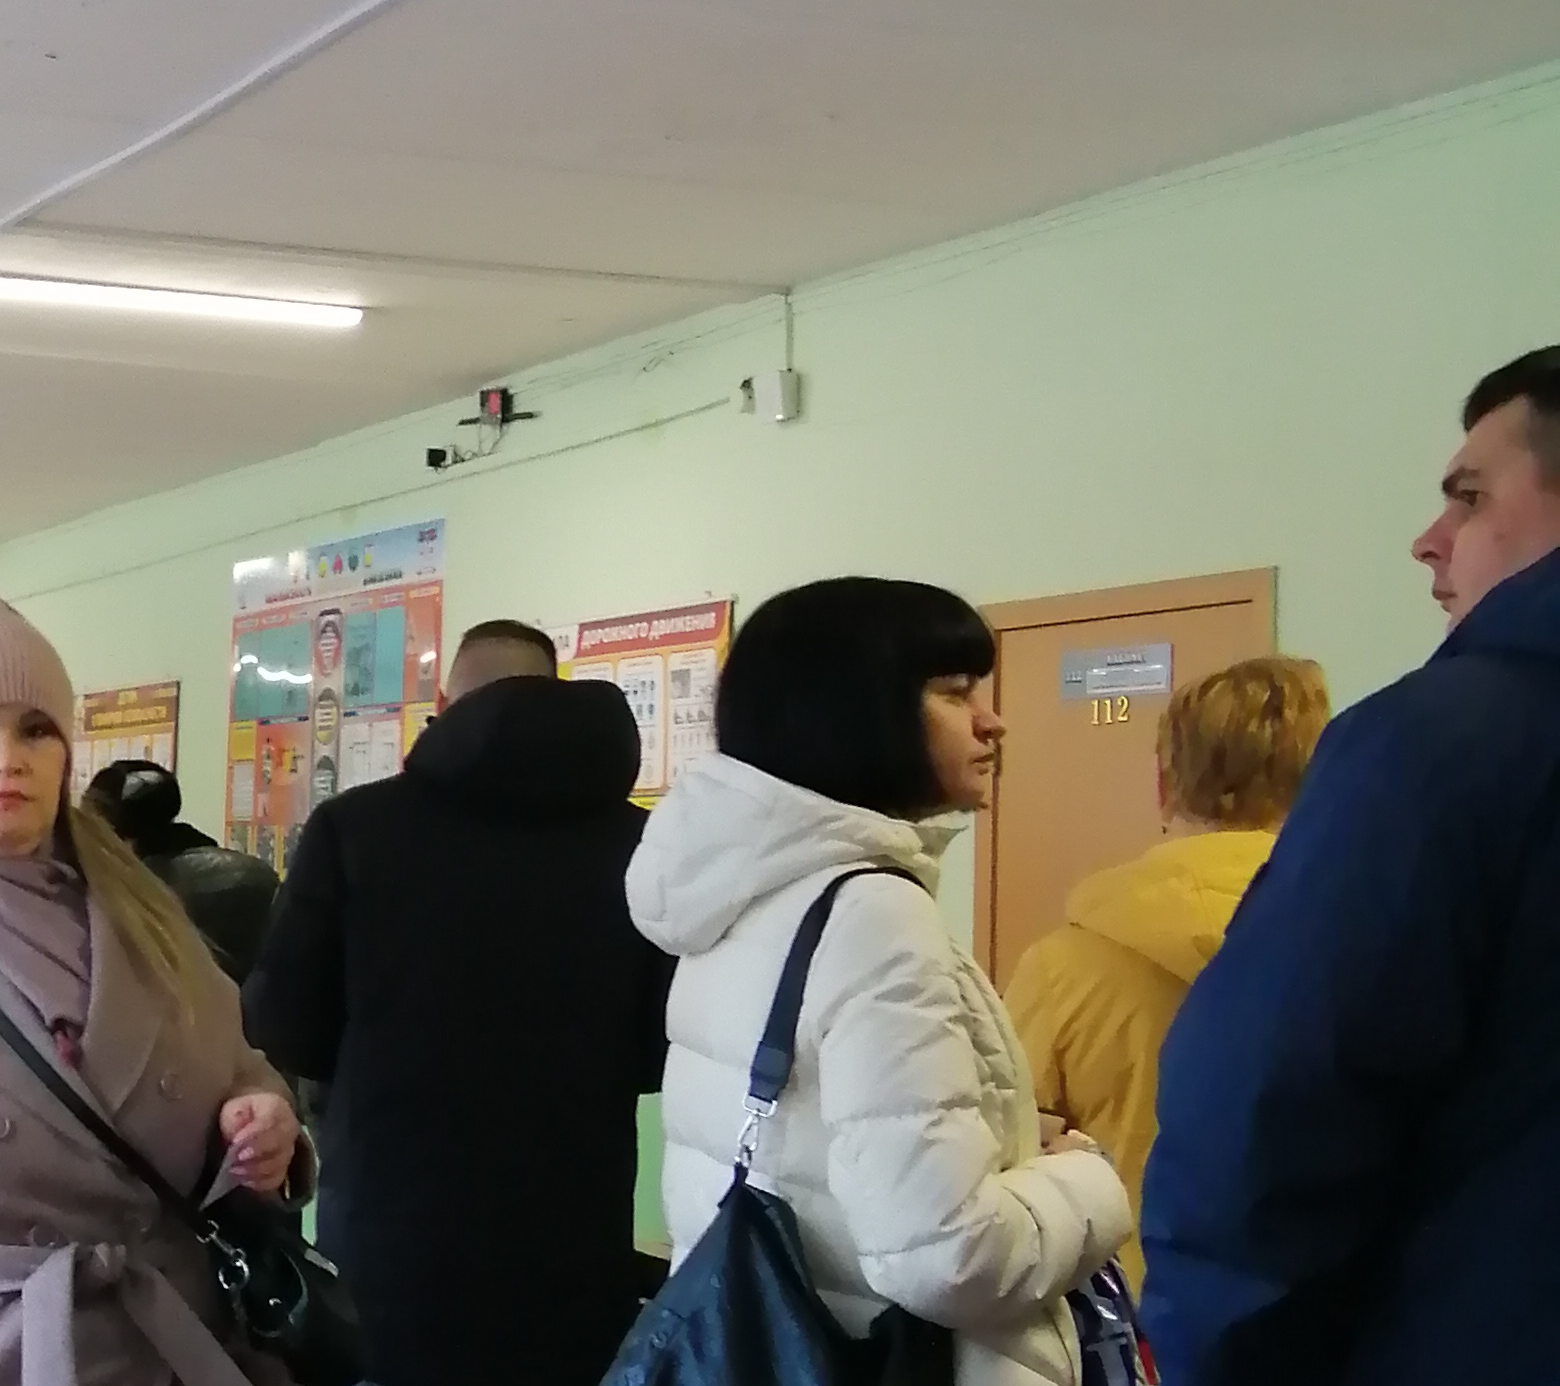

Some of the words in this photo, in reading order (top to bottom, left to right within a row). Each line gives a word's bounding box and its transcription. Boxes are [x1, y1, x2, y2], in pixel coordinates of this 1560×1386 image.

[582, 622, 648, 650] ДОРОЖНОГО
[650, 612, 716, 640] ДВИЖЕНИЯ
[1091, 695, 1130, 725] 112
